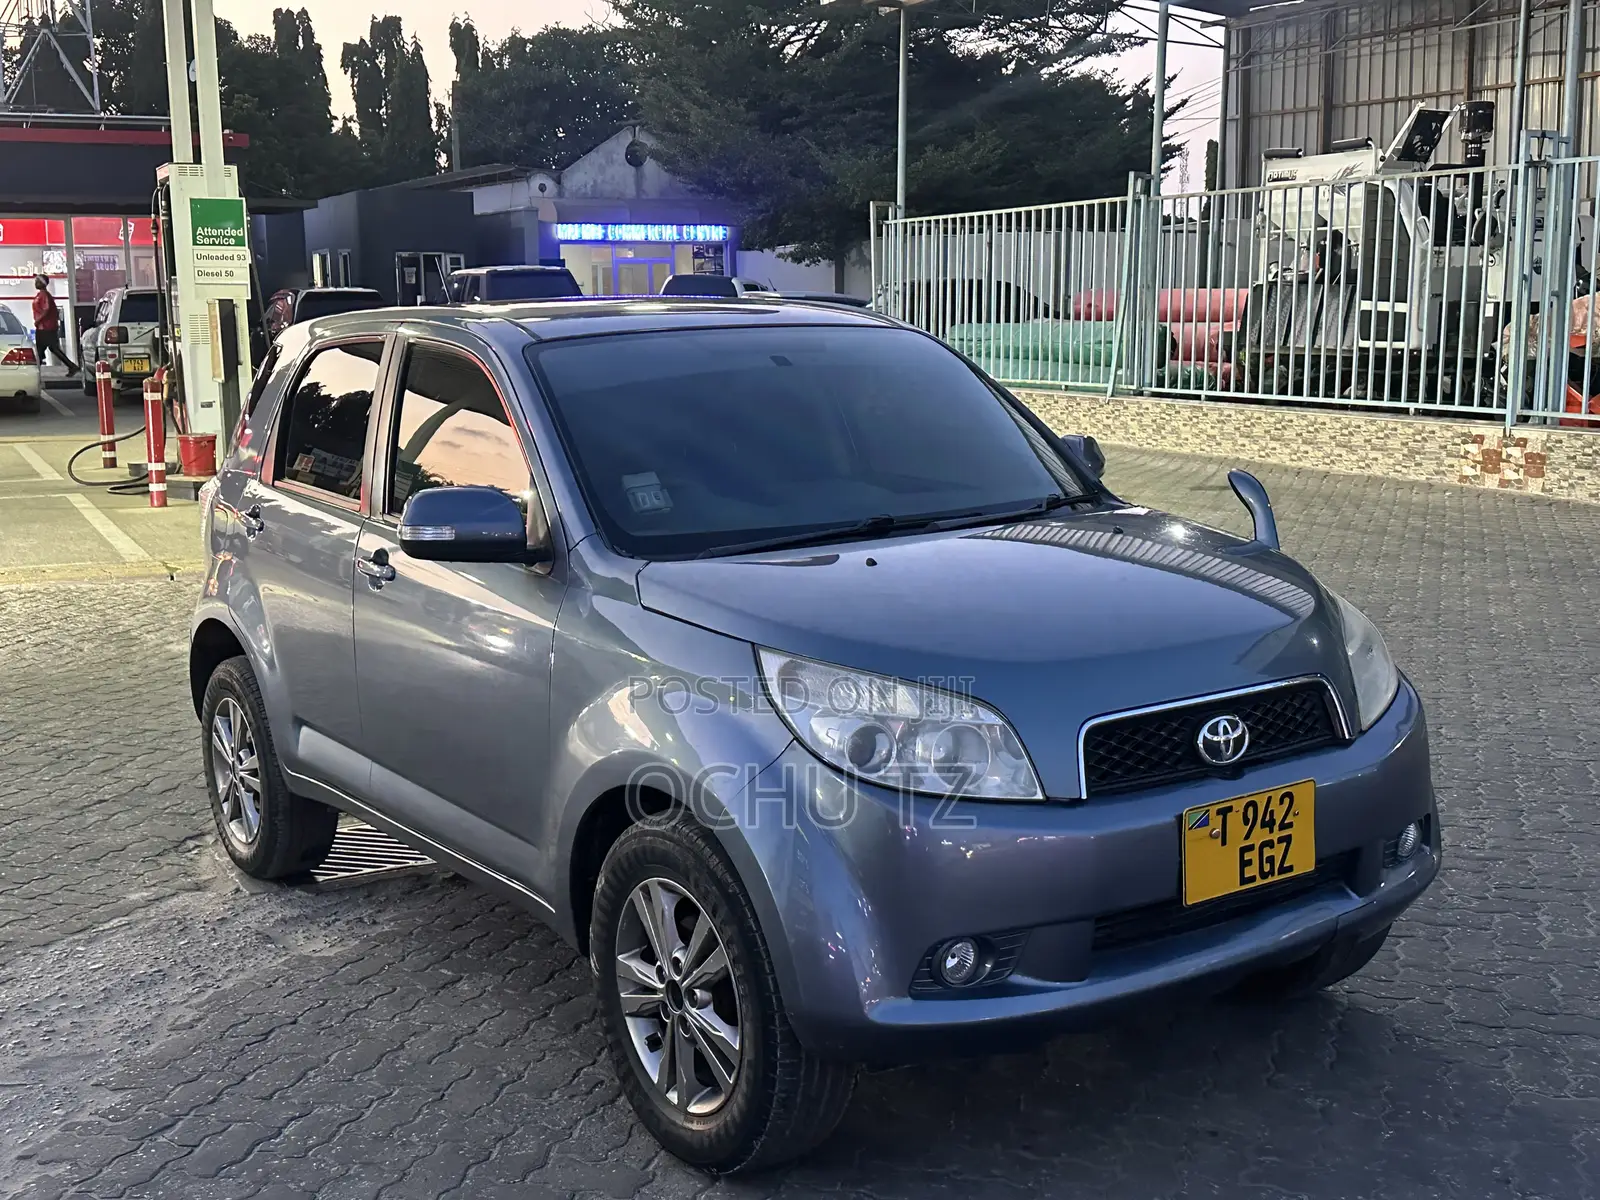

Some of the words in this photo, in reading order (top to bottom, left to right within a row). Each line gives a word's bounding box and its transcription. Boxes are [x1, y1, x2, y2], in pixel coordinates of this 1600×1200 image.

[196, 226, 244, 237] Attended
[196, 235, 236, 245] Service
[196, 253, 235, 261] Unleaded
[224, 270, 235, 278] 50
[1215, 805, 1233, 847] T
[1242, 790, 1295, 841] 942
[1238, 833, 1294, 886] EGZ
